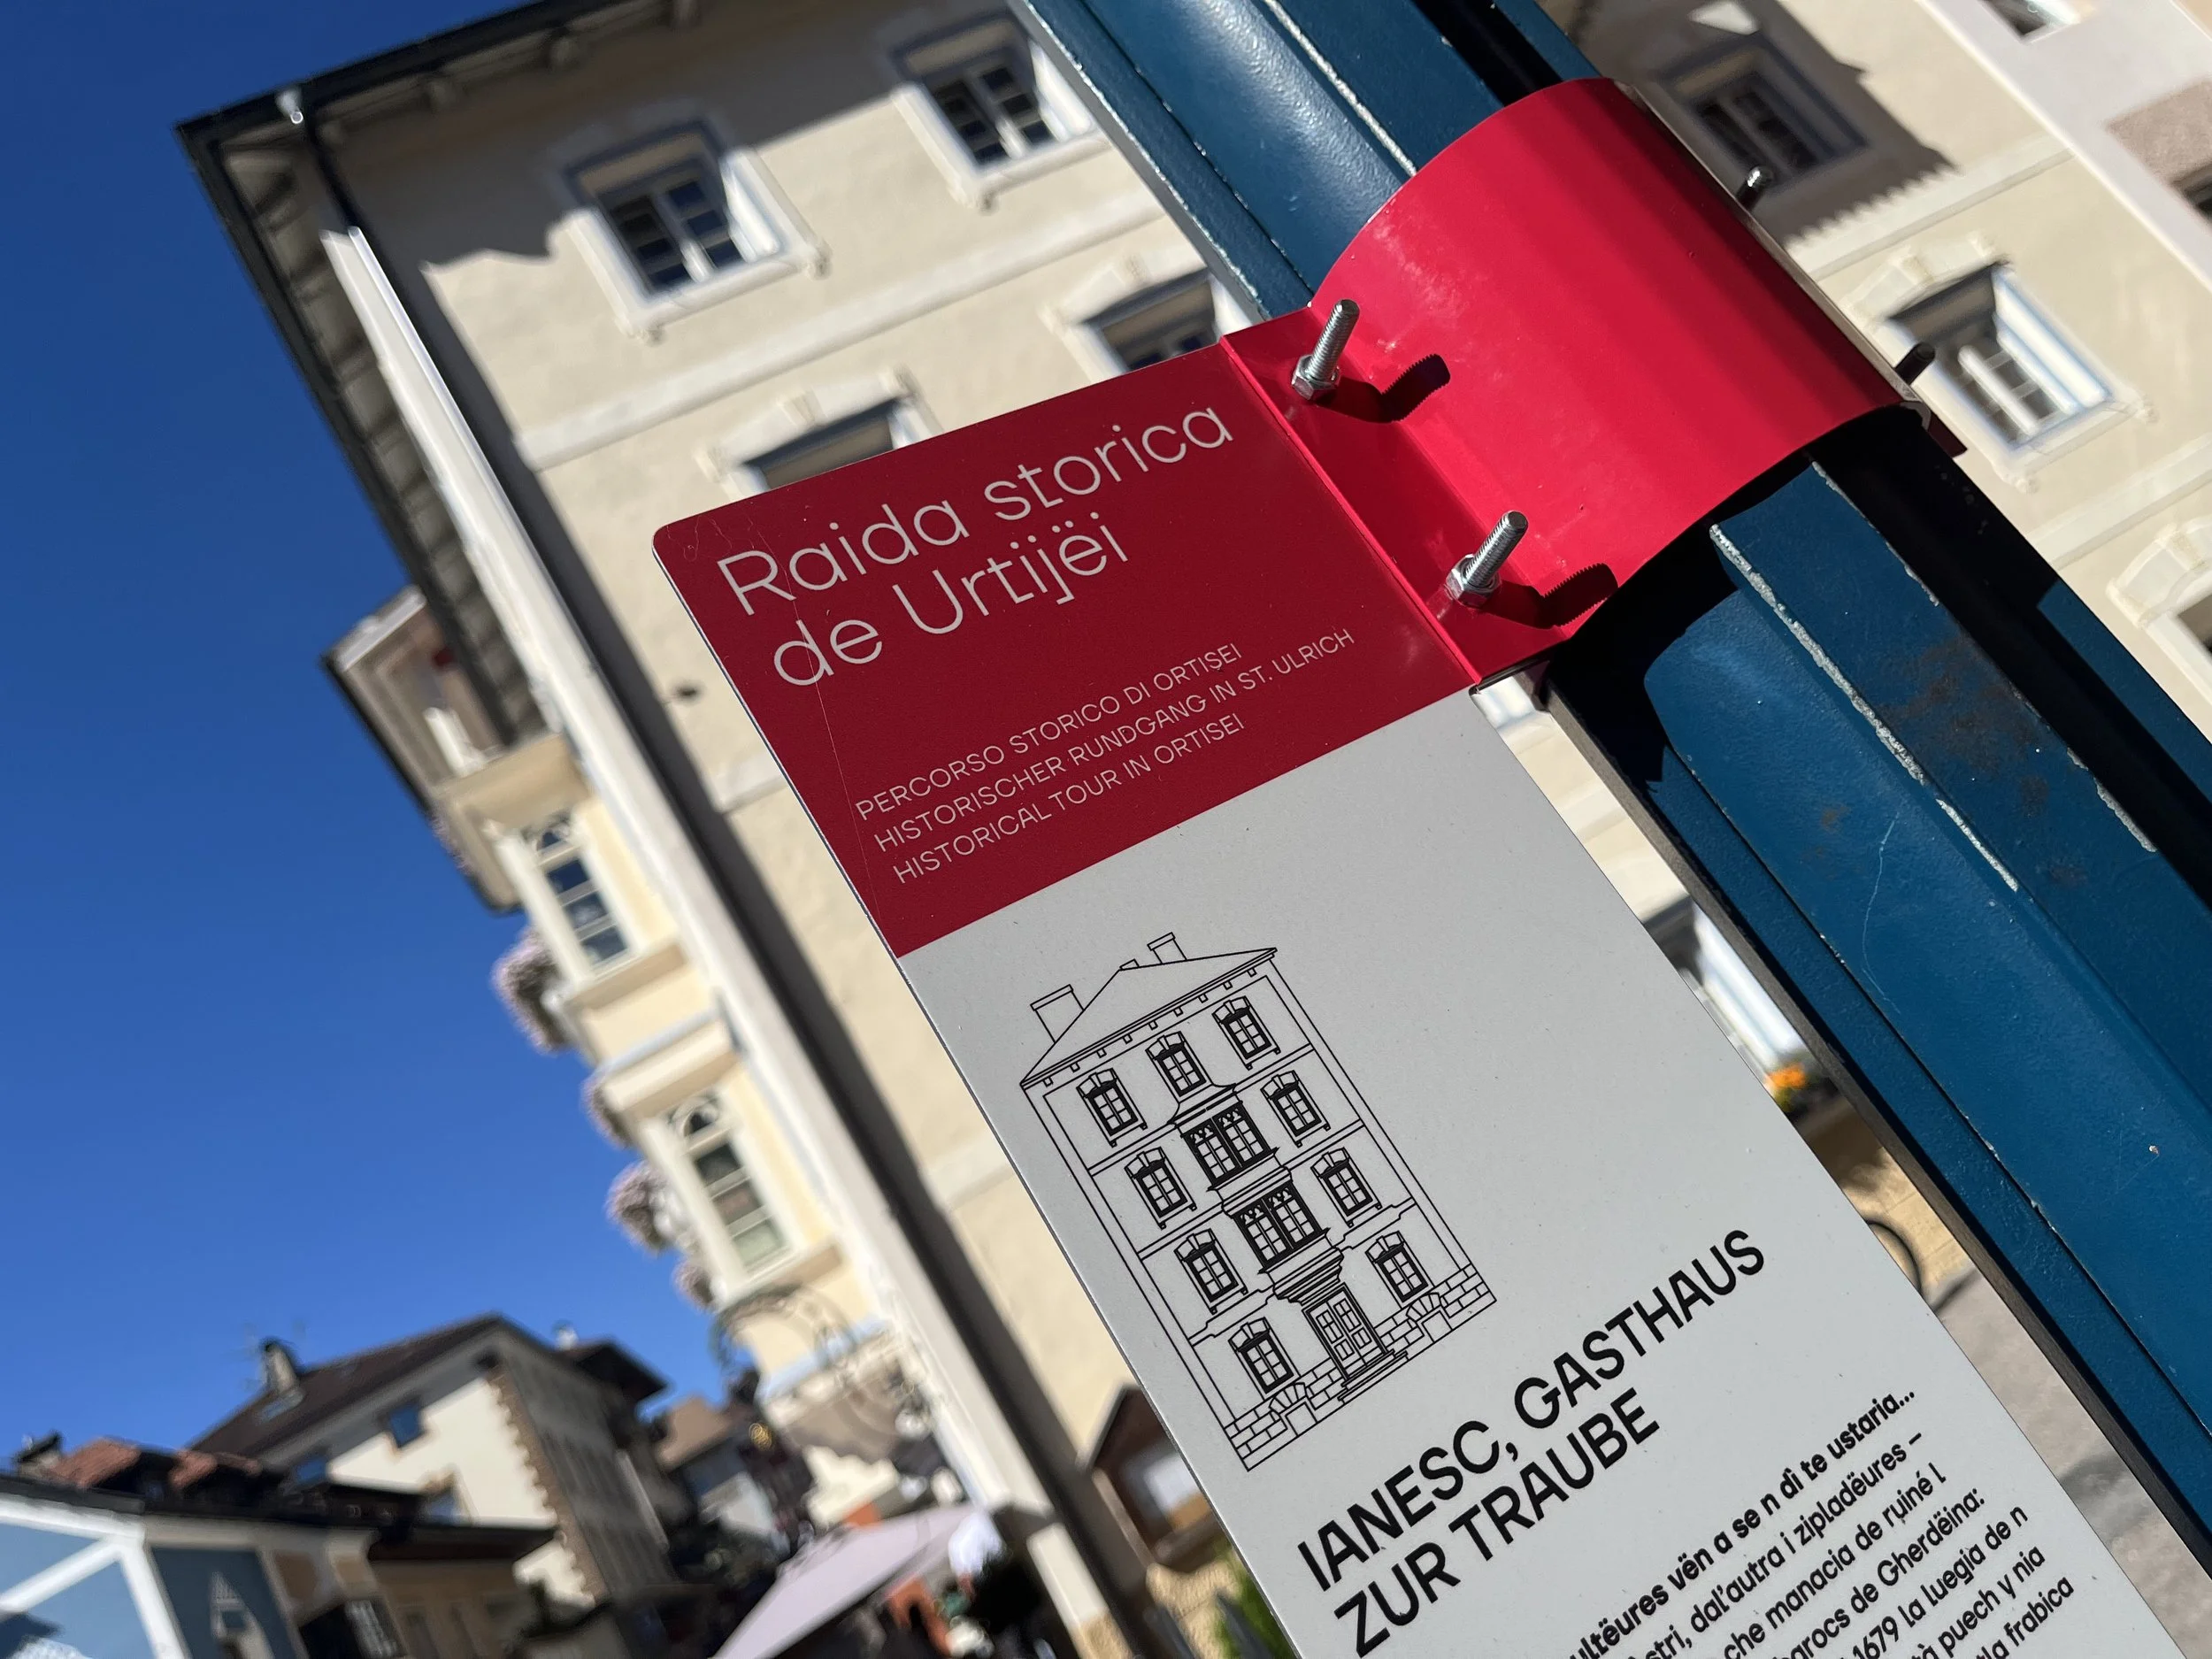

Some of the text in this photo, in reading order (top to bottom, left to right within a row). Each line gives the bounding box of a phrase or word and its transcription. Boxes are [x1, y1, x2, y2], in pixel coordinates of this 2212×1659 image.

[718, 408, 1233, 615] Raida storica
[774, 512, 1127, 685] de Urtijëi
[856, 643, 1241, 820] PERCORSO STORICO DI ORTISEI
[874, 629, 1354, 851] HISTORISCHER RUNDGANG IN ST. ULRICH
[894, 713, 1243, 883] HISTORICAL TOUR IN ORTISEI
[1298, 1229, 1763, 1591] IANESC, GASTHAUS
[1668, 1548, 1714, 1590] vën
[1714, 1532, 1732, 1554] a
[1732, 1509, 1760, 1538] se
[1761, 1494, 1780, 1516] n
[1780, 1468, 1804, 1499] dì
[1801, 1455, 1827, 1480] te
[1827, 1392, 1914, 1459] ustaria...
[1334, 1387, 1659, 1658] ZUR TRAUBE
[1724, 1463, 1946, 1659] che manacia de ruiné l
[1773, 1488, 1985, 1659] arocs de Gherdëina:
[1780, 1532, 1795, 1554] i
[1793, 1444, 1906, 1546] zipladëures
[1898, 1599, 1926, 1627] la
[1921, 1544, 1985, 1607] luegia
[1985, 1522, 2010, 1550] de
[2010, 1507, 2028, 1527] n
[1938, 1590, 2001, 1658] puech
[1997, 1574, 2016, 1599] y
[2013, 1547, 2045, 1583] nia
[1977, 1578, 2074, 1659] la frabica
